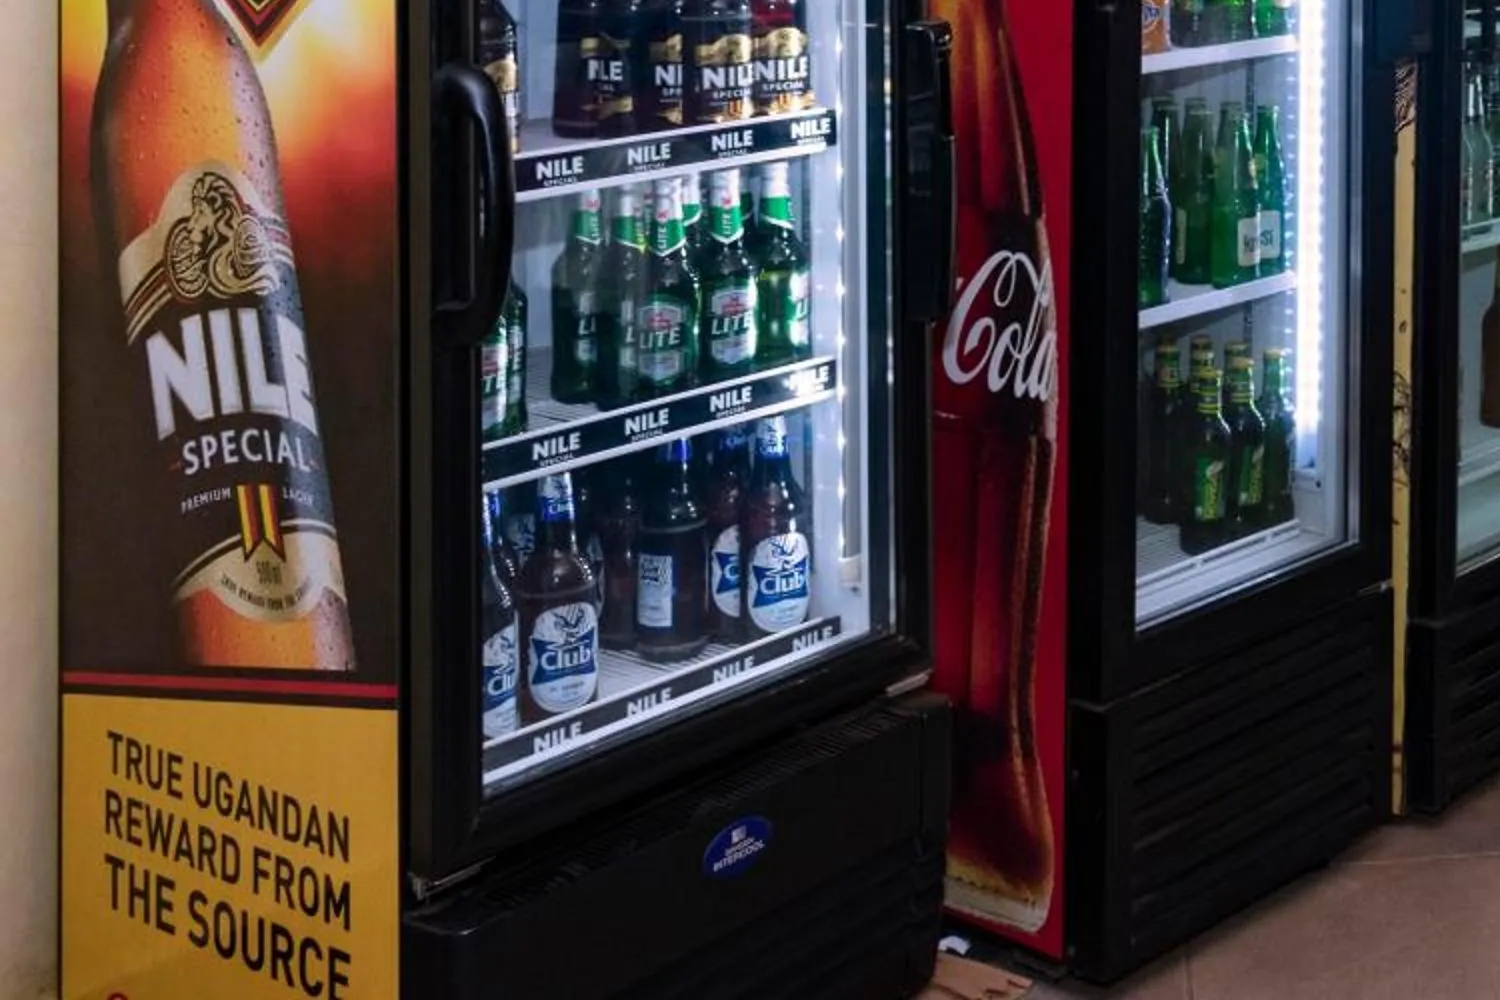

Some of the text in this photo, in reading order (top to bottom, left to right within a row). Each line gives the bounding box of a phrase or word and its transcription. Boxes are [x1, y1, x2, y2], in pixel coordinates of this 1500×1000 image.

[655, 64, 682, 86] NI
[711, 129, 753, 152] NILE
[791, 117, 831, 139] NILE
[535, 155, 584, 181] NILE
[627, 142, 672, 166] NILE
[640, 328, 681, 350] LITE
[145, 308, 319, 441] NILE
[709, 385, 752, 413] NILE
[624, 408, 669, 436] NILE
[182, 428, 311, 475] SPECIAL
[532, 431, 581, 460] NILE
[760, 570, 805, 595] Club
[792, 625, 833, 653] NILE
[541, 645, 591, 670] Club
[713, 656, 754, 684] NILE
[487, 673, 514, 695] Clu
[626, 687, 673, 719] NILE
[533, 720, 583, 755] NILE
[107, 730, 350, 862] TRUE UGANDAN
[105, 789, 351, 931] REWARD FROM
[105, 853, 351, 1000] THE SOURCE
